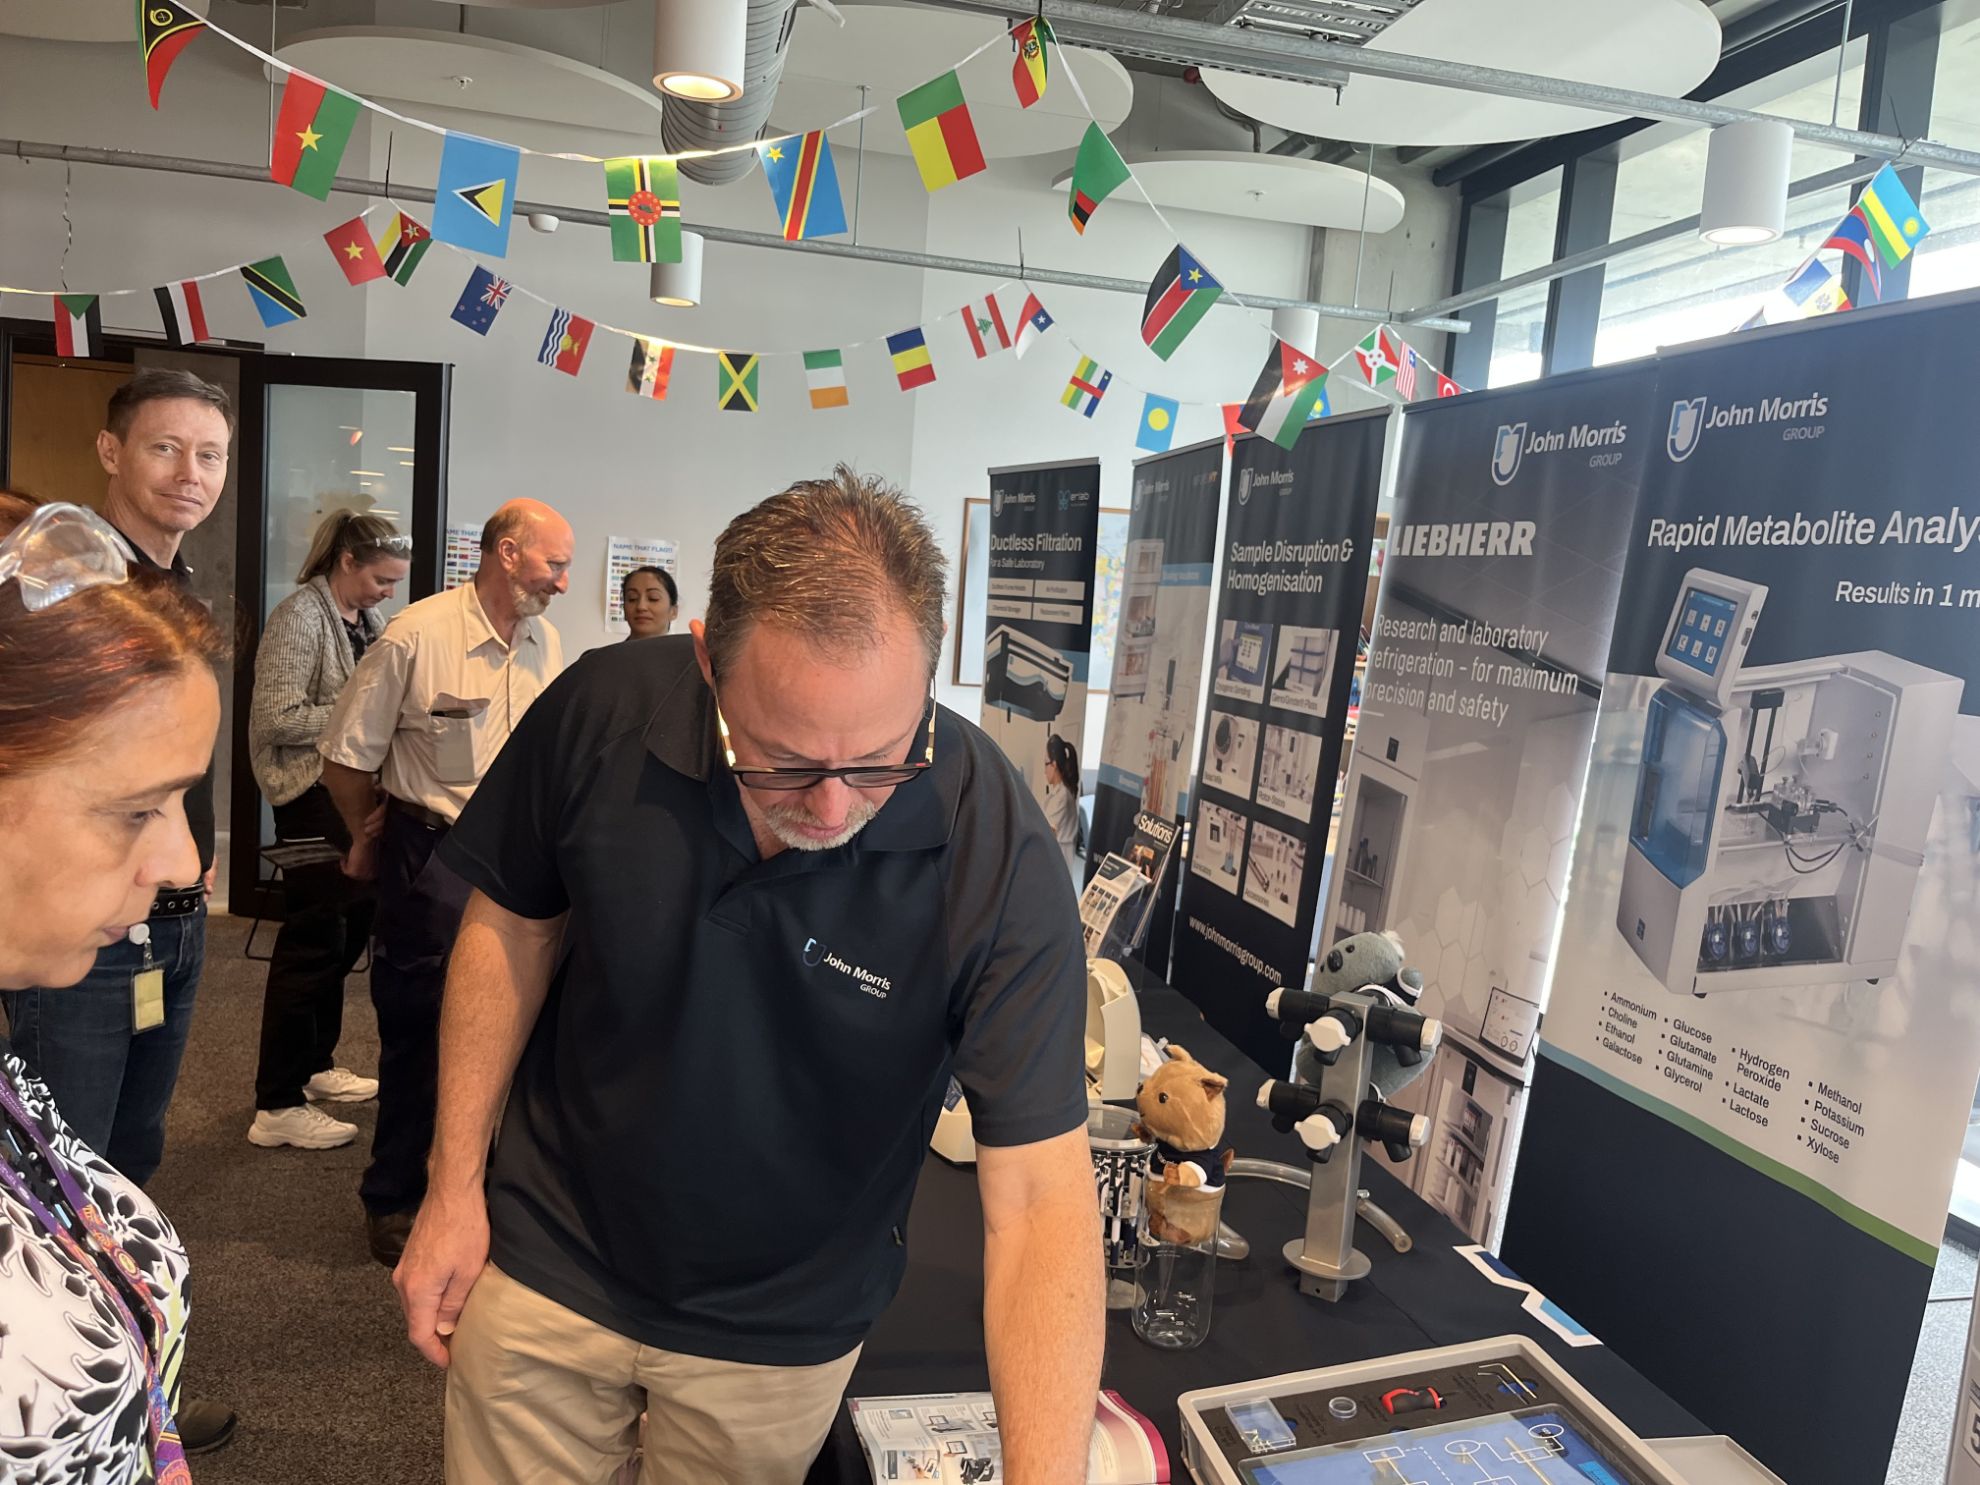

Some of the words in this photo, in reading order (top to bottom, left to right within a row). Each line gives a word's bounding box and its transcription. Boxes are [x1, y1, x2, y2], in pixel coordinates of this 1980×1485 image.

[1706, 404, 1754, 428] John
[1758, 392, 1828, 422] Morris
[1525, 431, 1564, 455] John
[1568, 420, 1627, 450] Morris
[1783, 426, 1825, 440] GROUP
[1589, 454, 1623, 468] GROUP
[1252, 473, 1270, 487] John
[1271, 469, 1294, 484] Morris
[1004, 494, 1017, 504] John
[1018, 492, 1036, 504] Morris
[446, 528, 459, 536] AME
[991, 533, 1034, 552] Ductless
[1036, 532, 1082, 552] Filtration
[1390, 521, 1536, 556] LIEBHERR
[1647, 515, 1720, 552] Rapid
[1722, 510, 1876, 546] Metabolite
[1879, 506, 1980, 552] Analy
[1231, 540, 1273, 567] Sample
[1275, 539, 1339, 567] Disruption
[1341, 538, 1354, 562] &
[1227, 570, 1322, 596] Homogenisation
[1836, 581, 1910, 604] Results
[1914, 582, 1934, 606] in
[1939, 584, 1953, 606] 1
[1377, 615, 1437, 642] Research
[1440, 619, 1467, 646] and
[1470, 622, 1549, 656] laboratory
[1370, 648, 1454, 678] refrigeration
[1472, 658, 1493, 684] for
[1497, 664, 1580, 695] maximum
[1366, 682, 1425, 708] precision
[1428, 686, 1455, 716] and
[1459, 692, 1509, 727] safety
[1138, 815, 1174, 844] Solutions
[1189, 916, 1282, 985] www.johnmorrisgroup.com
[824, 952, 852, 974] John
[852, 966, 892, 990] Morris
[860, 984, 887, 999] GROUP
[1611, 992, 1658, 1020] Ammonium
[1608, 1007, 1638, 1029] Choline
[1673, 1018, 1712, 1044] Glucose
[1605, 1022, 1636, 1044] Ethanol
[1602, 1037, 1643, 1065] Galactose
[1670, 1034, 1718, 1064] Glutamate
[1666, 1050, 1714, 1080] Glutamine
[1737, 1062, 1782, 1092] Peroxide
[1740, 1048, 1790, 1080] Hydrogen
[1664, 1066, 1703, 1093] Glycerol
[1733, 1082, 1770, 1108] Lactate
[1818, 1082, 1863, 1115] Methanol
[1730, 1098, 1769, 1128] Lactose
[1814, 1100, 1865, 1137] Potassium
[1810, 1118, 1850, 1150] Sucrose
[1806, 1136, 1840, 1164] Xylose
